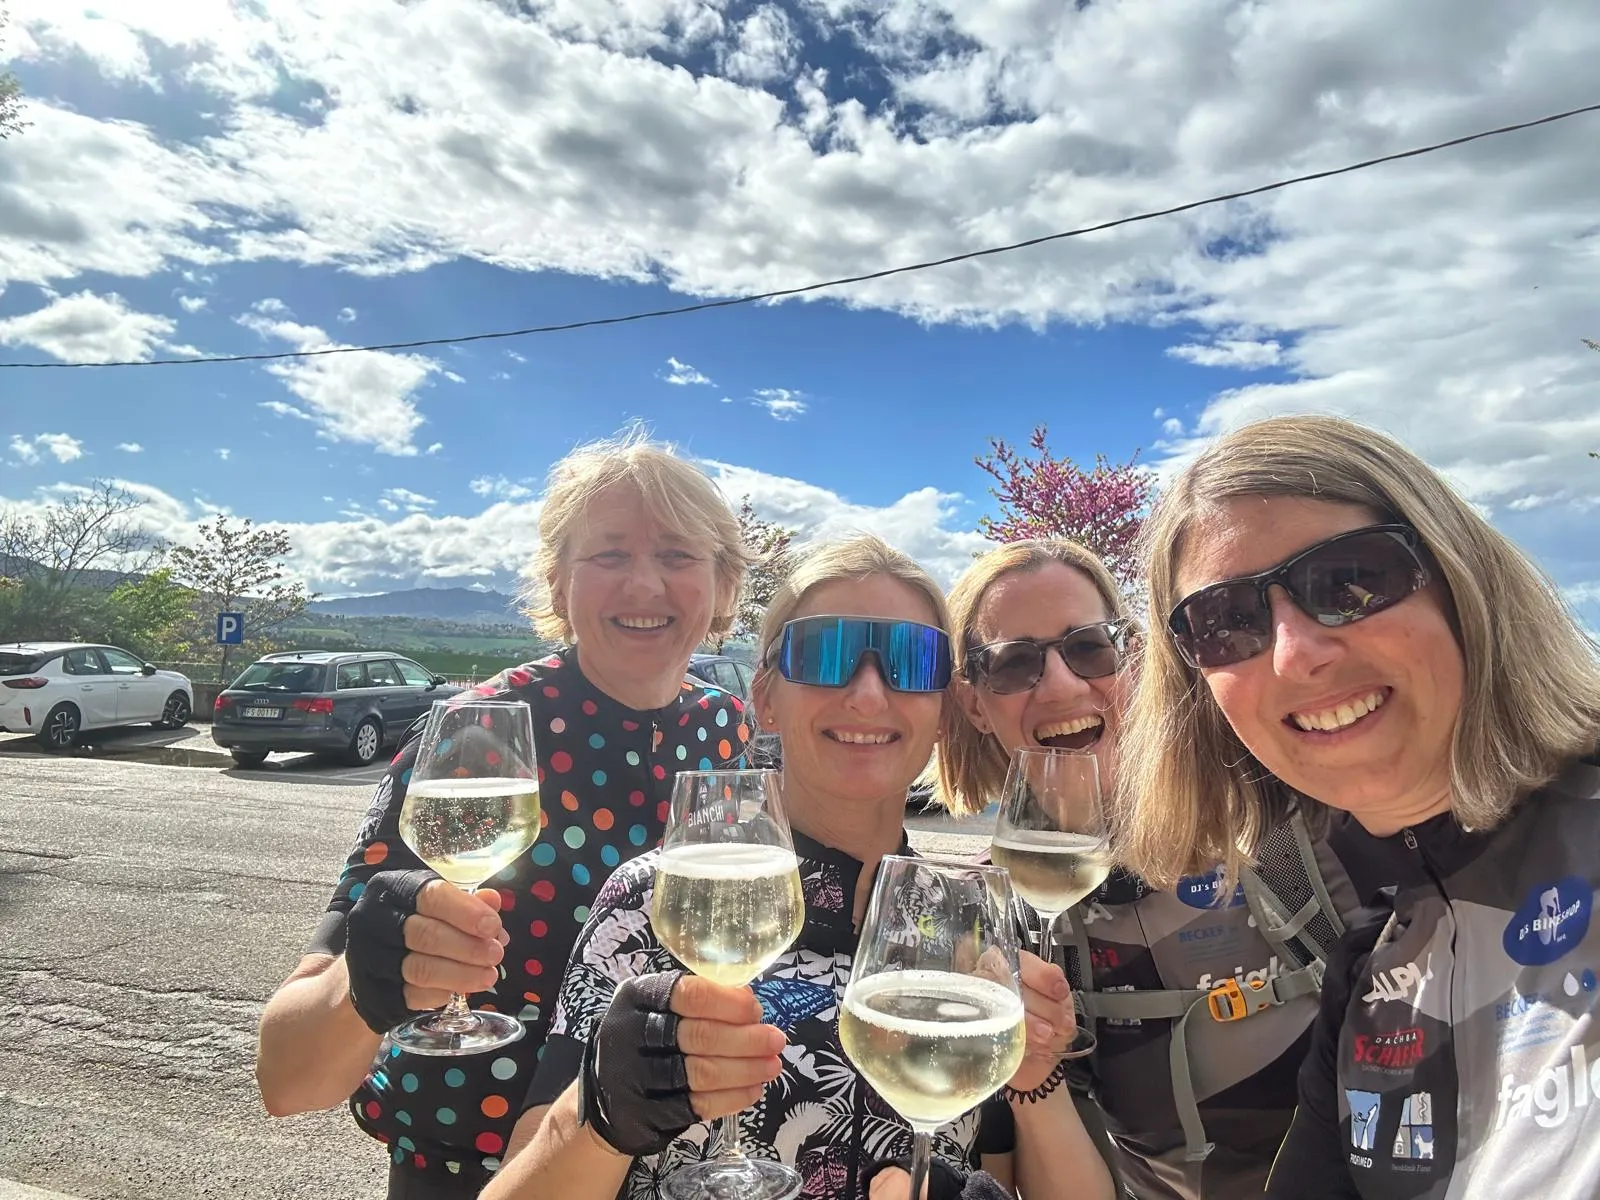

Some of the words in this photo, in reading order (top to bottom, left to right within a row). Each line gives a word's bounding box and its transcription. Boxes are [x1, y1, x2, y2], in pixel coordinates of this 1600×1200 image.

[221, 616, 237, 641] P
[688, 805, 724, 828] BIANCHI
[1191, 883, 1210, 893] DJ's
